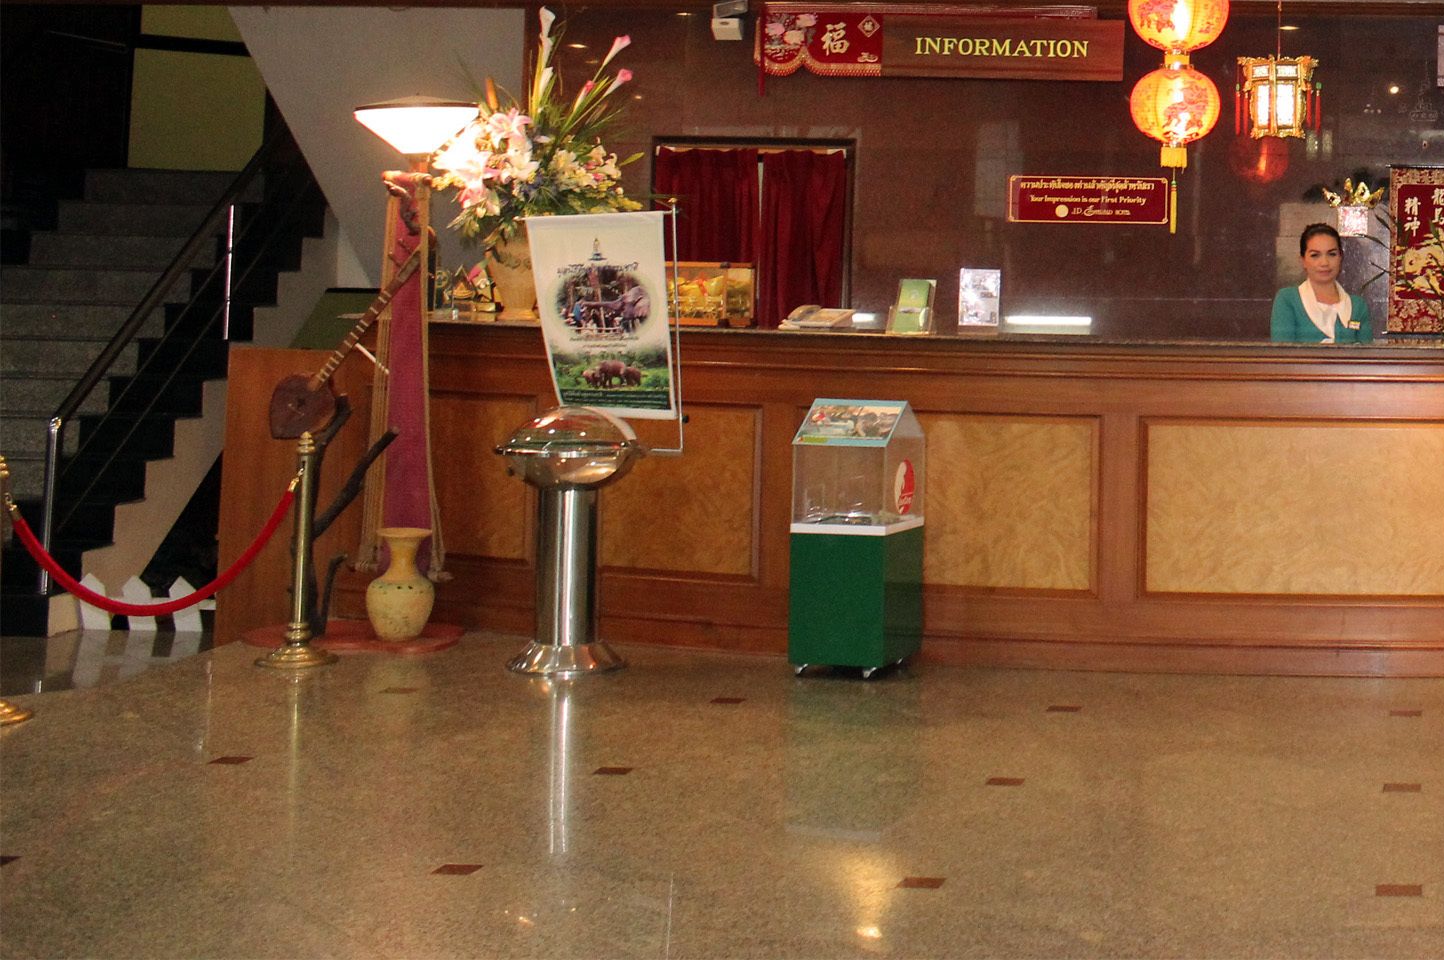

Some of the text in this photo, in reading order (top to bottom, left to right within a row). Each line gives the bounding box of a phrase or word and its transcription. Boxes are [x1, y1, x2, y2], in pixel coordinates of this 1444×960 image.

[821, 22, 849, 56] 福
[915, 37, 1088, 58] INFORMATION
[1030, 194, 1044, 203] Your
[1045, 195, 1080, 204] Impression
[1082, 195, 1088, 203] is
[1101, 195, 1117, 204] First
[1119, 196, 1147, 206] Priority
